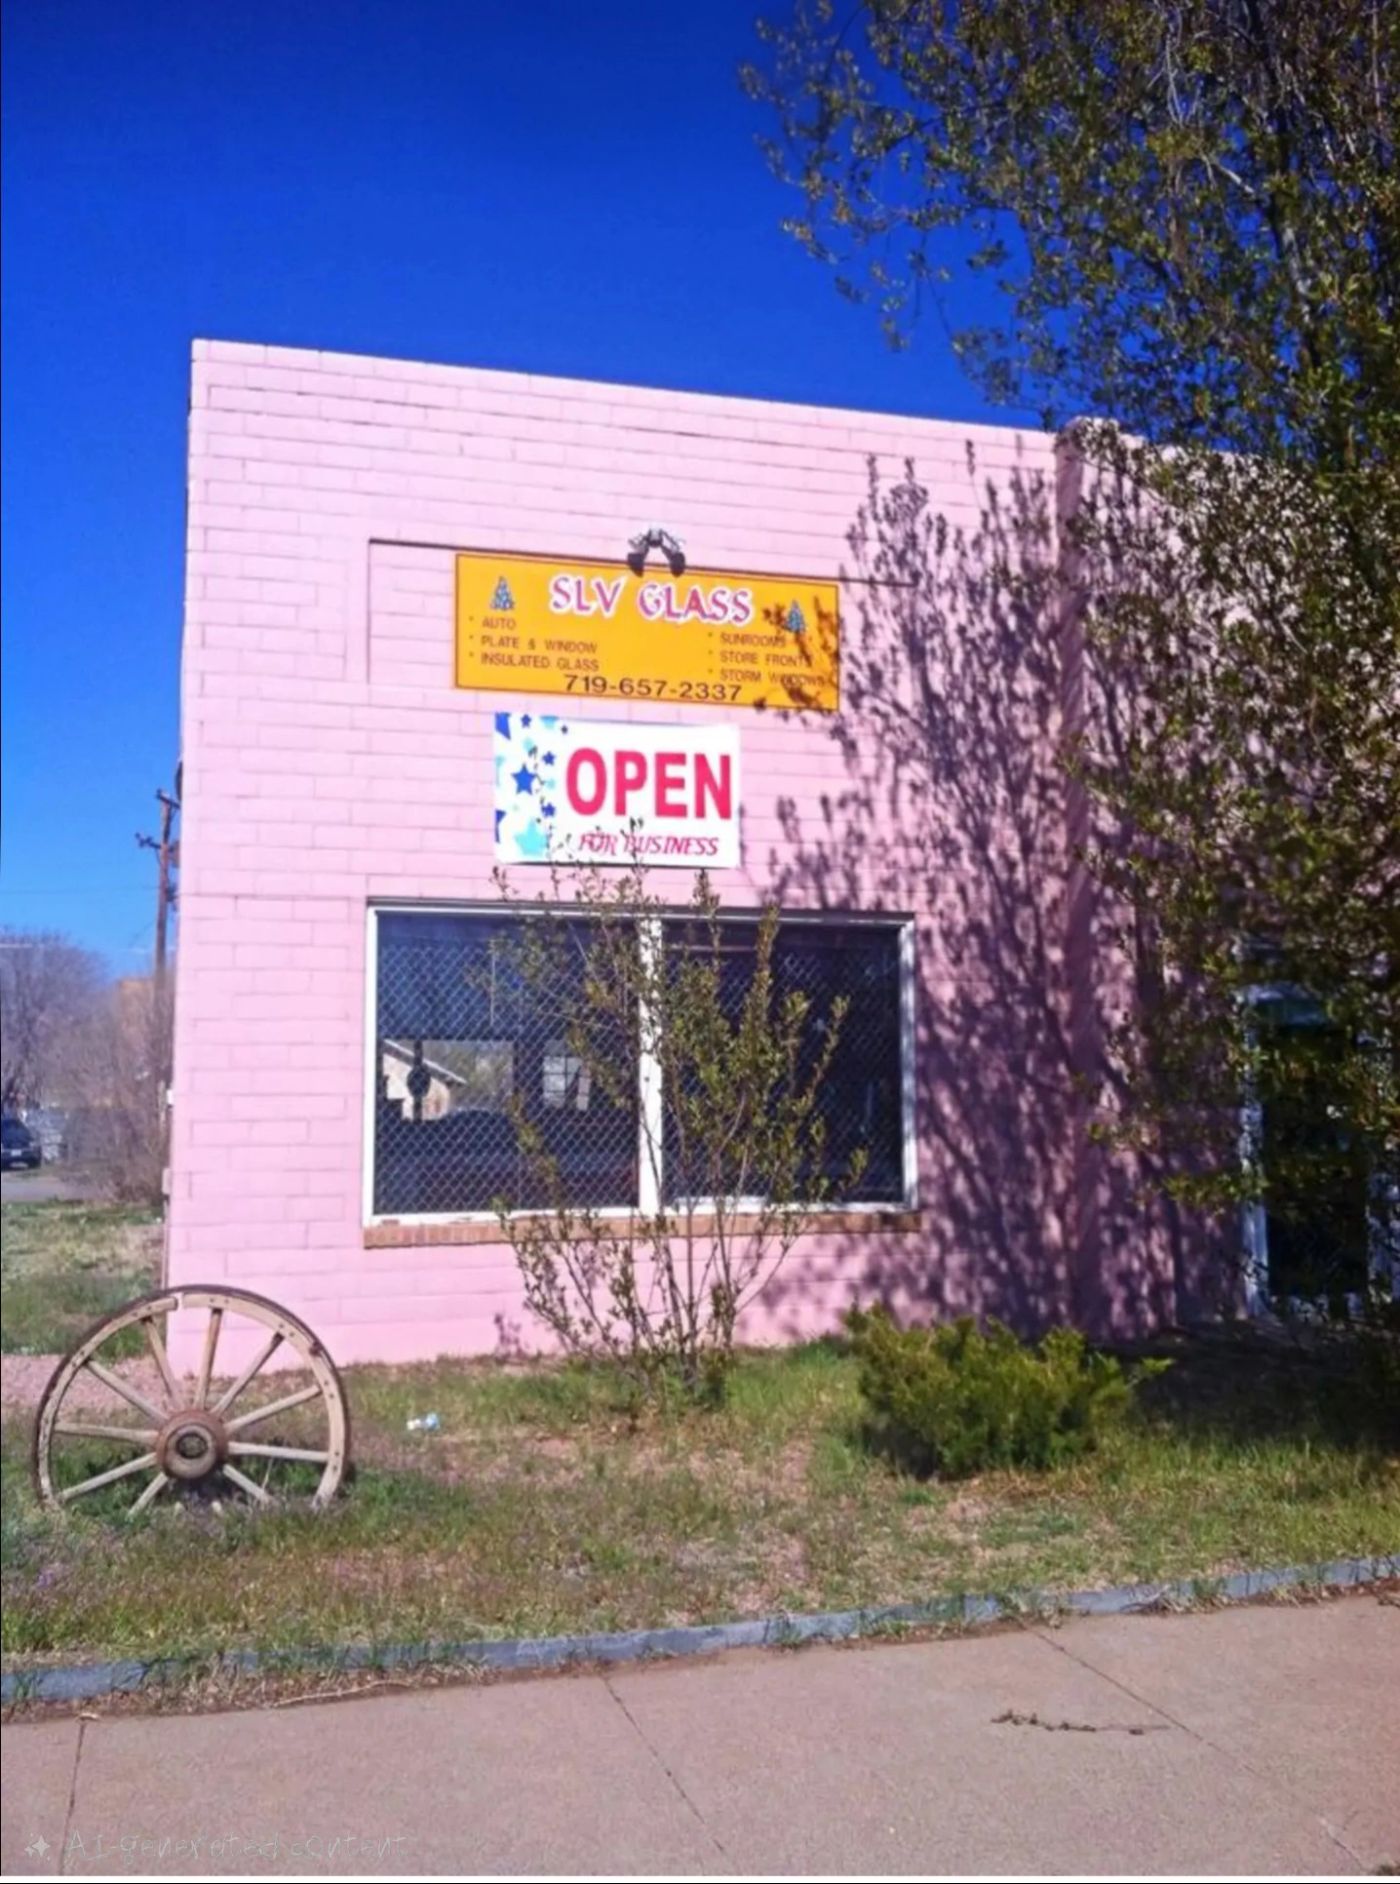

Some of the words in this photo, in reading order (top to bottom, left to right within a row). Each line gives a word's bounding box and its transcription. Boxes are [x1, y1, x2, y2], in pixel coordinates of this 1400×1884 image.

[551, 574, 624, 615] SLV
[638, 582, 752, 625] GLASS
[482, 617, 516, 631] AUTO
[480, 634, 519, 649] PLATE
[544, 639, 598, 655] WINDOW
[720, 632, 786, 648] SUNROOMS
[480, 653, 549, 669] INSULATED
[557, 657, 600, 672] GLASS
[720, 650, 758, 665] STORE
[766, 654, 811, 668] FRONT
[720, 668, 762, 682] STORM
[565, 674, 742, 702] 719-657-2337
[566, 747, 732, 821] OPEN
[578, 832, 618, 856] FOR
[624, 832, 719, 856] BUSINESS
